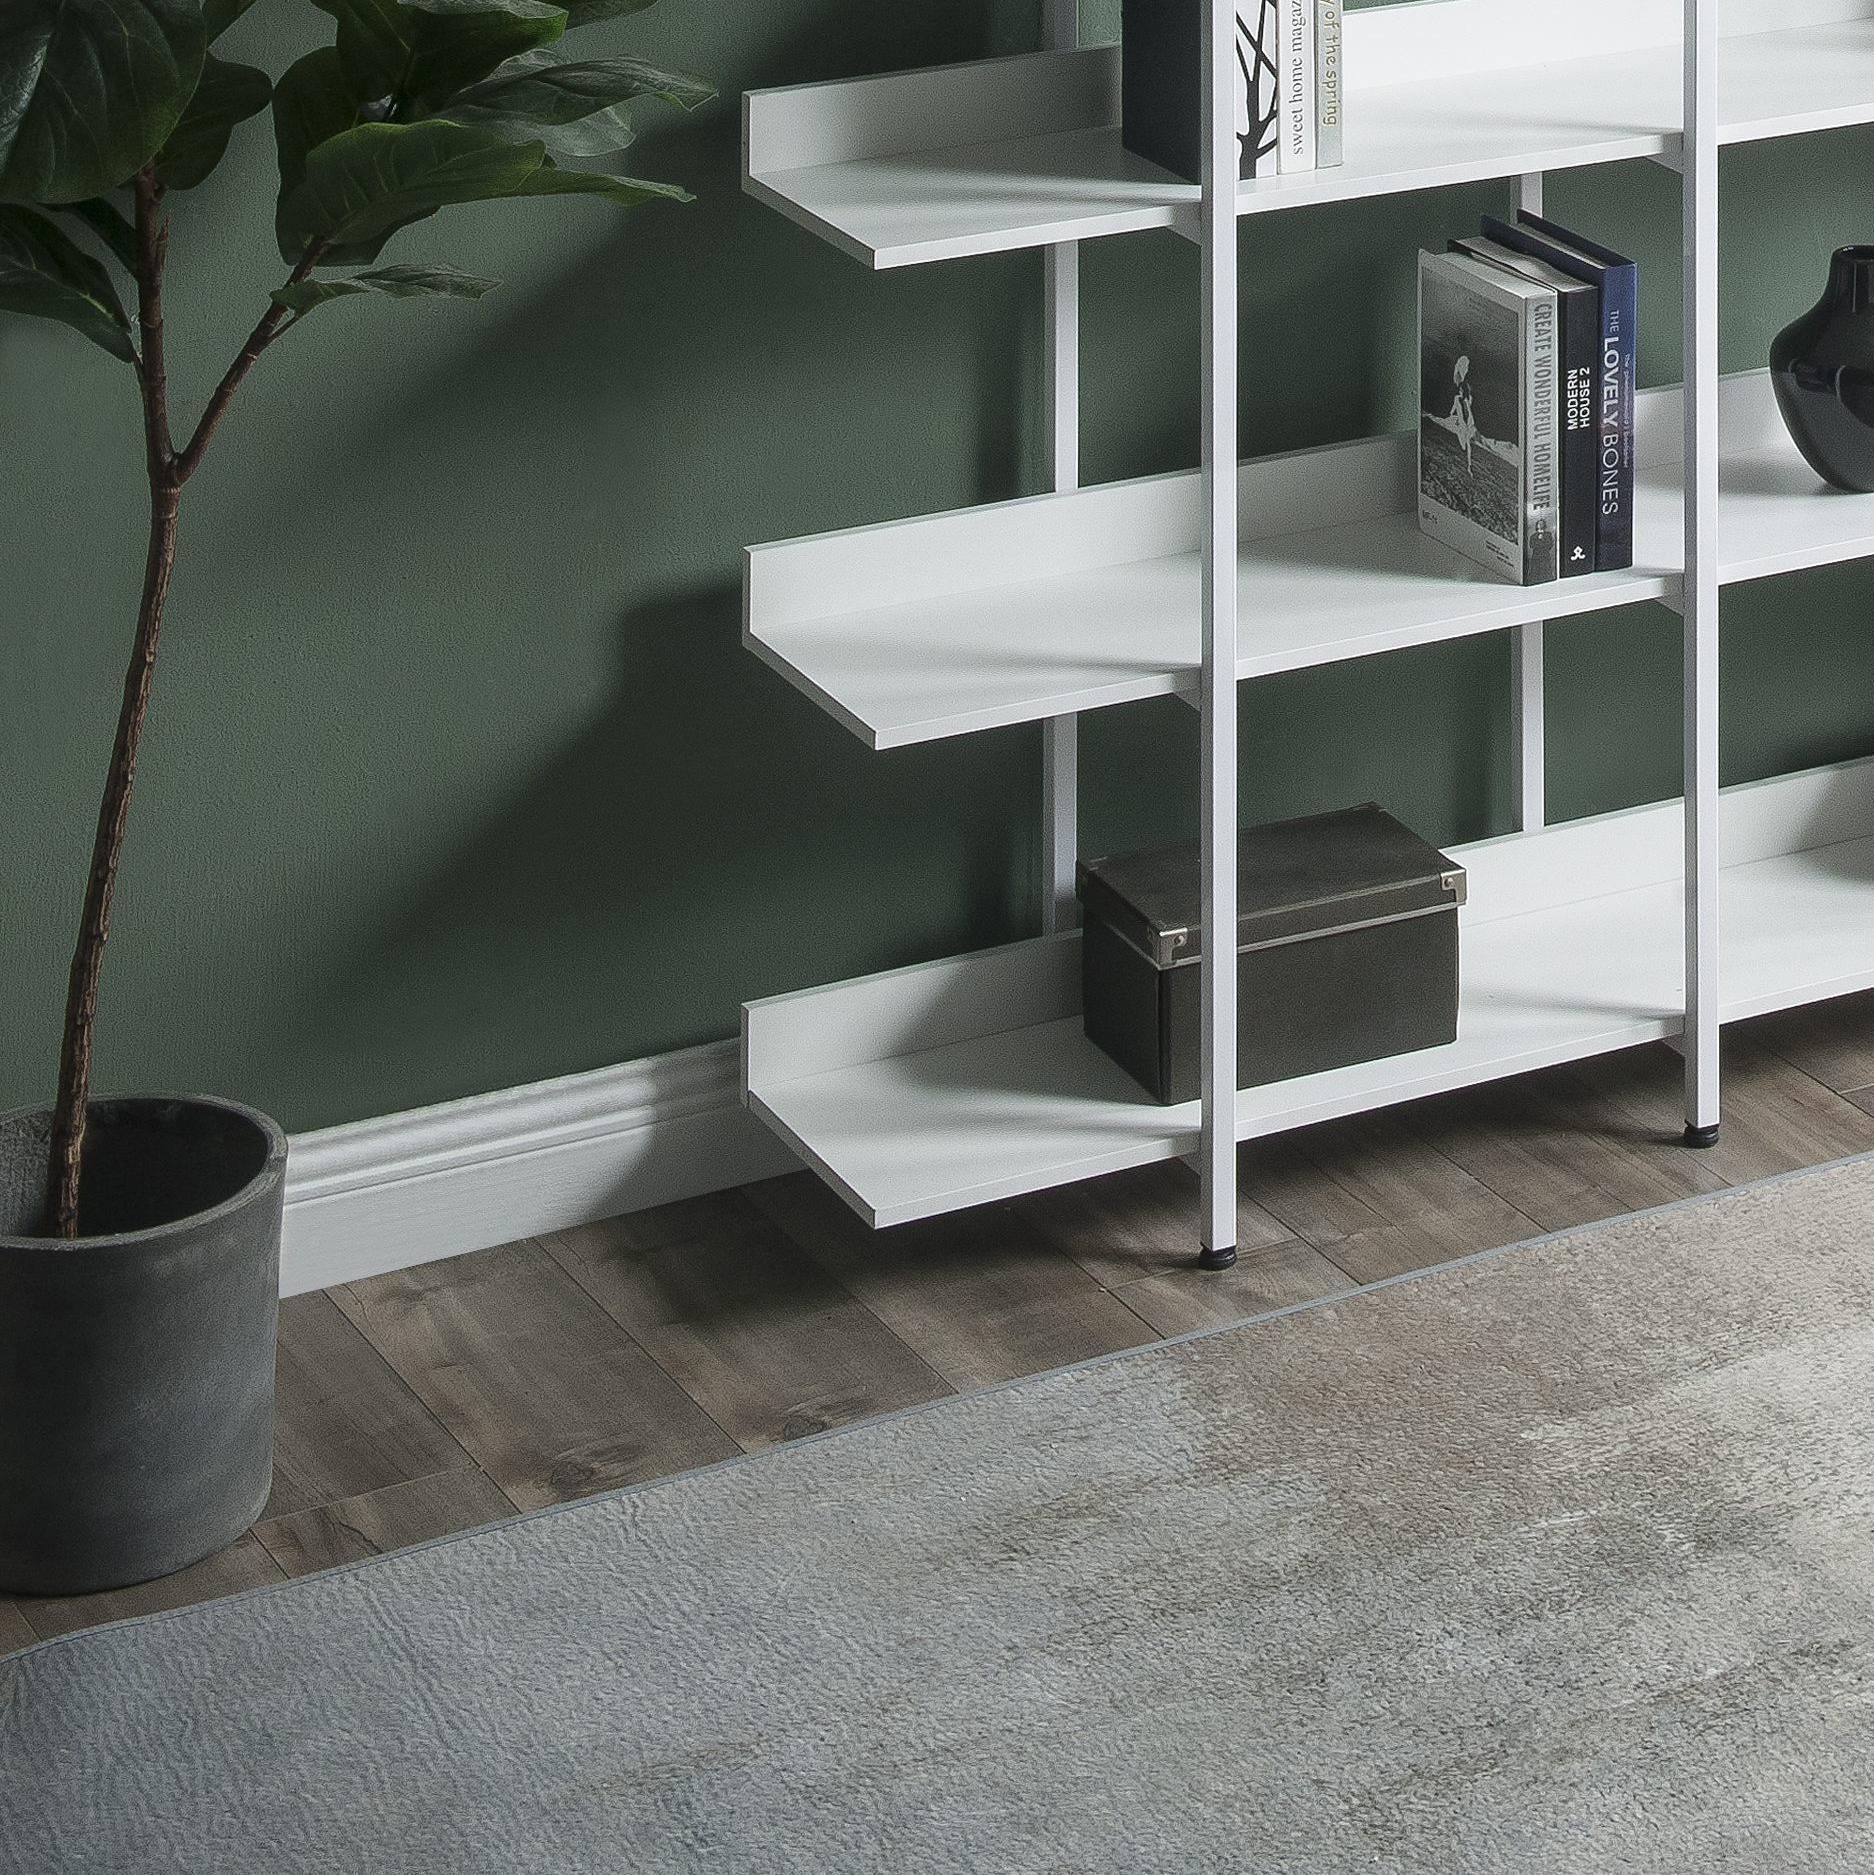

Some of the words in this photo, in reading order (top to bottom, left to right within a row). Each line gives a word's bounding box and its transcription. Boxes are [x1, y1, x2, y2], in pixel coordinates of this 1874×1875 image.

[1324, 11, 1340, 29] of
[1325, 34, 1340, 66] the
[1289, 57, 1303, 104] home
[1322, 70, 1341, 126] spring
[1291, 108, 1303, 155] sweet
[1534, 303, 1552, 352] CREATE
[1610, 309, 1619, 332] THE
[1580, 367, 1590, 375] 2
[1604, 337, 1619, 427] LOVELY
[1534, 354, 1552, 440] WONDERFUL
[1567, 369, 1579, 431] MODERN
[1579, 378, 1590, 428] HOUSE
[1533, 443, 1551, 511] HOMELIFE
[1602, 434, 1619, 515] BONES
